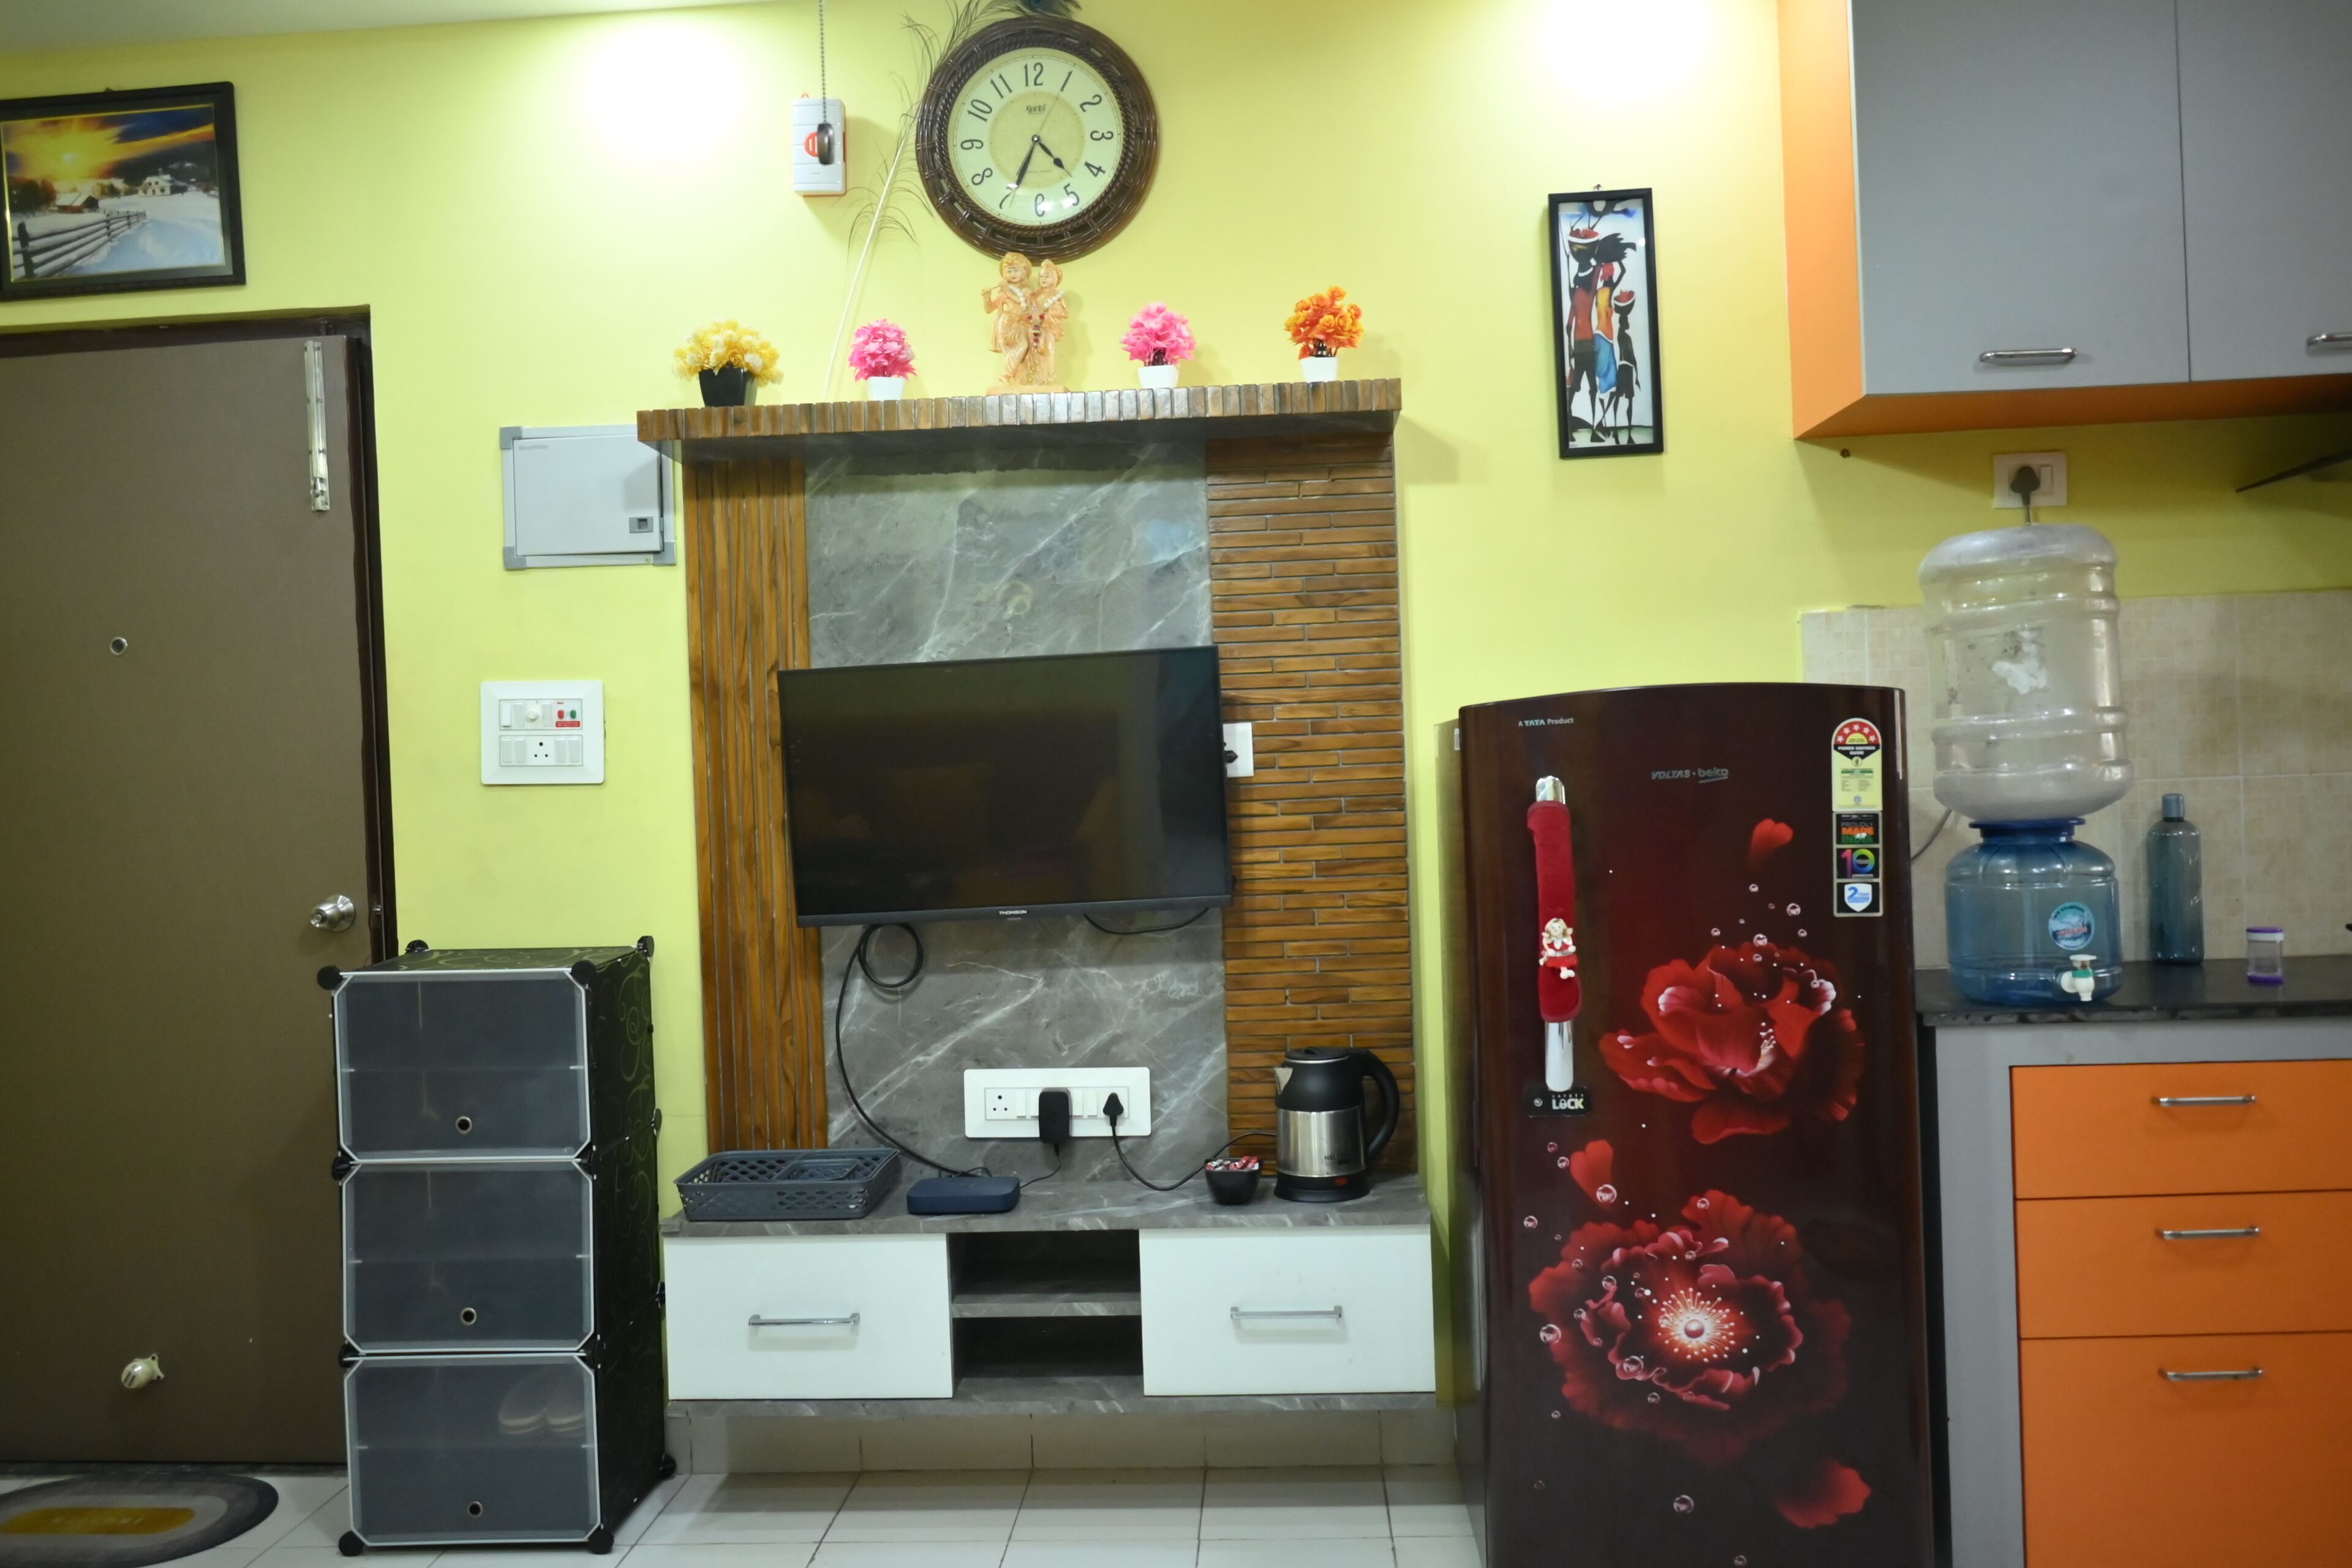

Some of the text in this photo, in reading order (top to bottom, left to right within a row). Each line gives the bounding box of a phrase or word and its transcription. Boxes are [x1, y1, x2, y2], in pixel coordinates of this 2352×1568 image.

[1023, 62, 1044, 87] 12
[1061, 70, 1073, 92] 1
[990, 73, 1013, 99] 11
[967, 99, 992, 122] 10
[1080, 94, 1102, 112] 2
[960, 138, 984, 151] 9
[1090, 130, 1114, 141] 3
[971, 168, 993, 186] 8
[1084, 160, 1106, 178] 4
[999, 186, 1018, 209] 7
[1063, 183, 1080, 206] 5
[1034, 194, 1046, 217] 6
[1651, 767, 1729, 780] VOLTAS beko
[1841, 849, 1875, 879] 10
[1847, 886, 1858, 899] 2
[1552, 1098, 1584, 1110] LOCK
